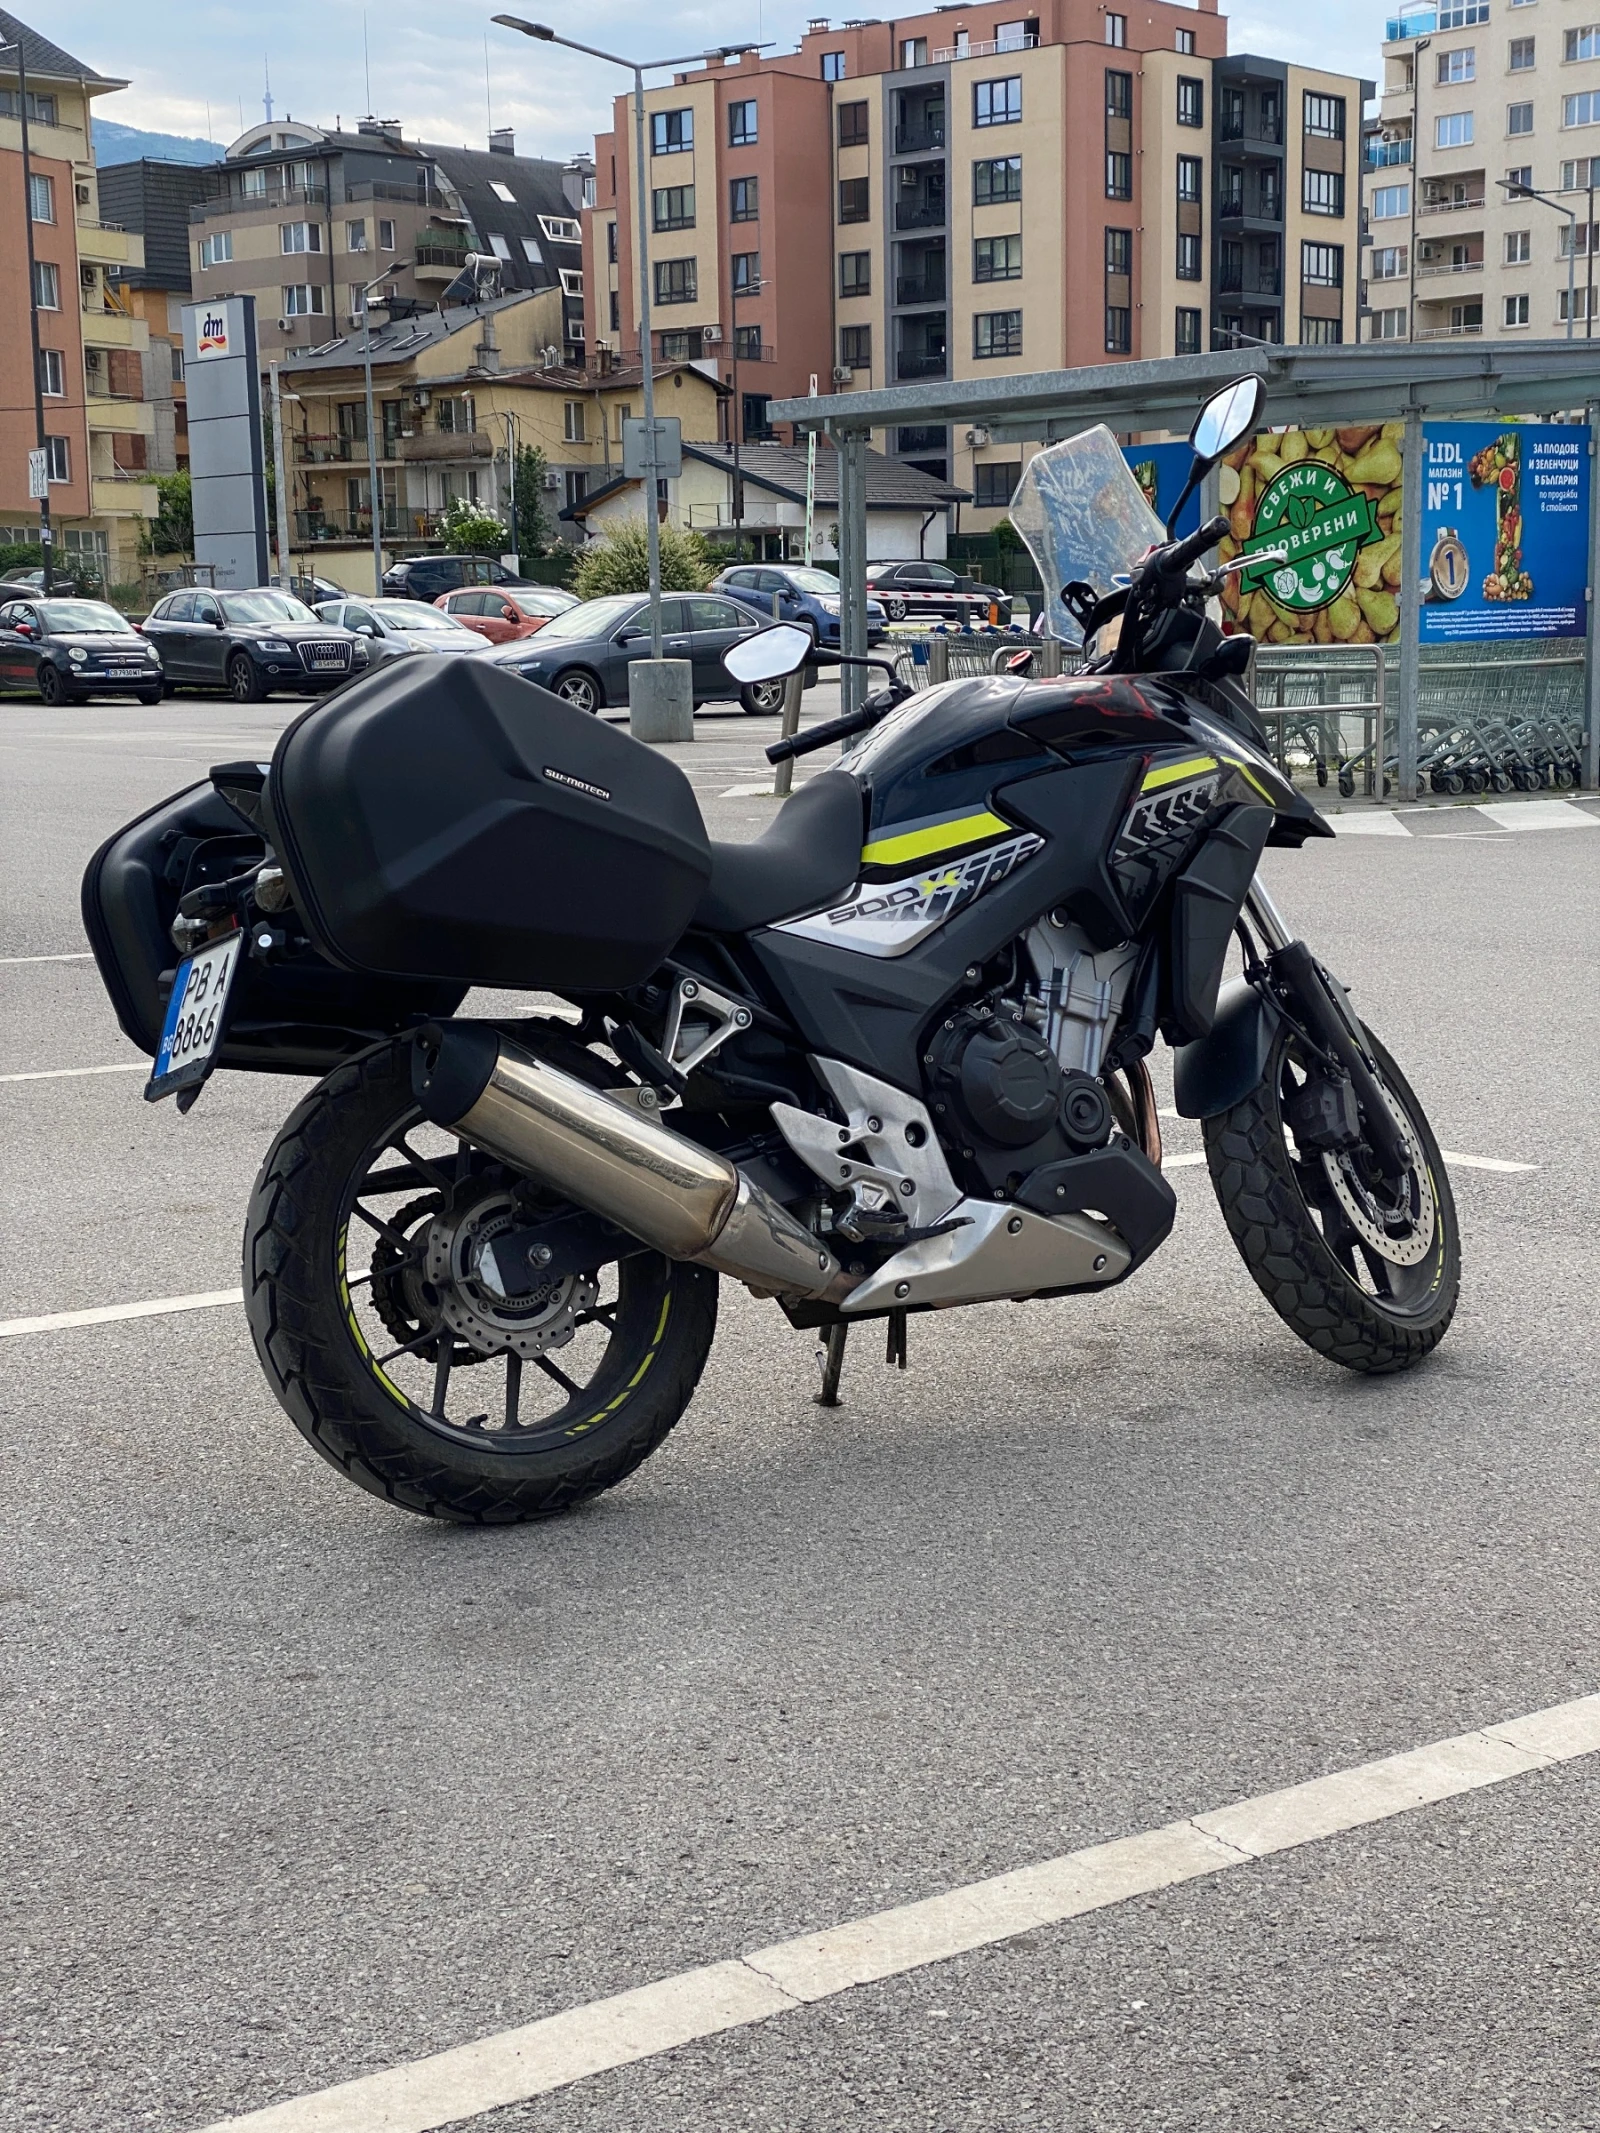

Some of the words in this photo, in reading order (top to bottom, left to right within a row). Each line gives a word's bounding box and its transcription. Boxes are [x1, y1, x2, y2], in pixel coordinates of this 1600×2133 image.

[203, 312, 223, 337] dm
[1429, 442, 1463, 463] LIDL
[1533, 444, 1543, 454] ЗА
[1544, 443, 1579, 455] ПЛОДОВЕ
[1428, 468, 1463, 478] МАГАЗИН
[1528, 460, 1535, 469] И
[1535, 459, 1579, 471] ЗЕЛЕНЧУЦИ
[1535, 476, 1540, 485] В
[1541, 475, 1579, 485] БЪЛГАРИЯ
[1262, 470, 1317, 519] СВЕЖИ
[1323, 477, 1337, 495] И
[1453, 482, 1463, 510] 1
[1539, 491, 1547, 499] по
[1545, 503, 1578, 512] стойност
[1445, 550, 1455, 585] 1
[545, 769, 610, 799] SW-MOTECH
[825, 870, 960, 926] 500X
[181, 961, 212, 1009] PB
[213, 952, 230, 996] A
[172, 1002, 219, 1058] 8866
[162, 1035, 174, 1055] BG
